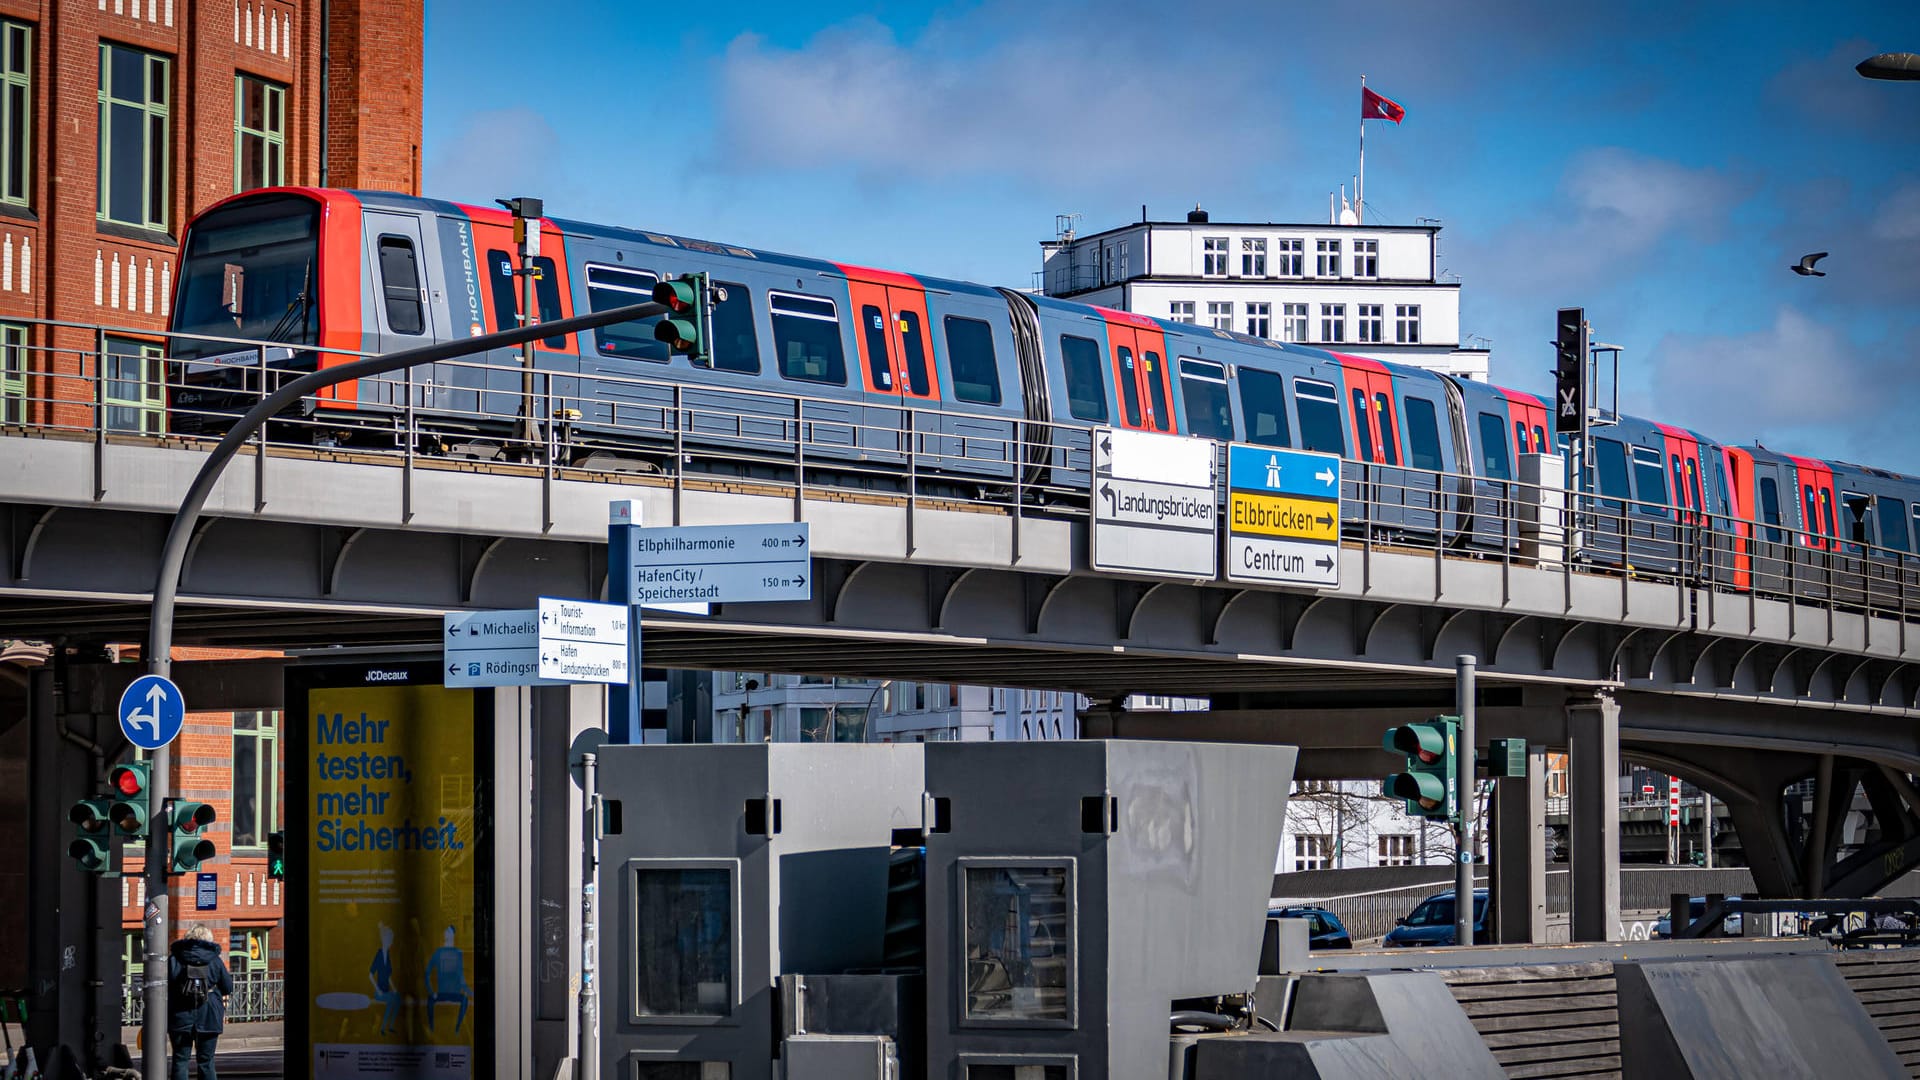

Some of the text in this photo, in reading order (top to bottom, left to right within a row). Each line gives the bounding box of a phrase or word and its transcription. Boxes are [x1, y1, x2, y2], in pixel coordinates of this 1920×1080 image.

[458, 222, 480, 322] HOCHBAHN
[1118, 489, 1213, 520] Landungsbrücken
[1234, 500, 1314, 531] Elbbrücken
[638, 536, 790, 554] Elbphilharmonie 400 m
[1244, 545, 1304, 574] Centrum
[638, 569, 696, 583] HafenCity
[762, 577, 790, 588] 150 m
[638, 585, 719, 601] Speicherstadt
[560, 604, 584, 619] Tourist-
[560, 621, 596, 637] Information
[560, 645, 577, 658] Hafen
[560, 662, 610, 678] Landungsbrücken
[612, 659, 621, 669] 800
[366, 670, 408, 681] JCDecaux
[317, 713, 390, 745] Mehr
[317, 752, 412, 784] testen,
[317, 784, 390, 816] mehr
[317, 816, 464, 852] Sicherheit.
